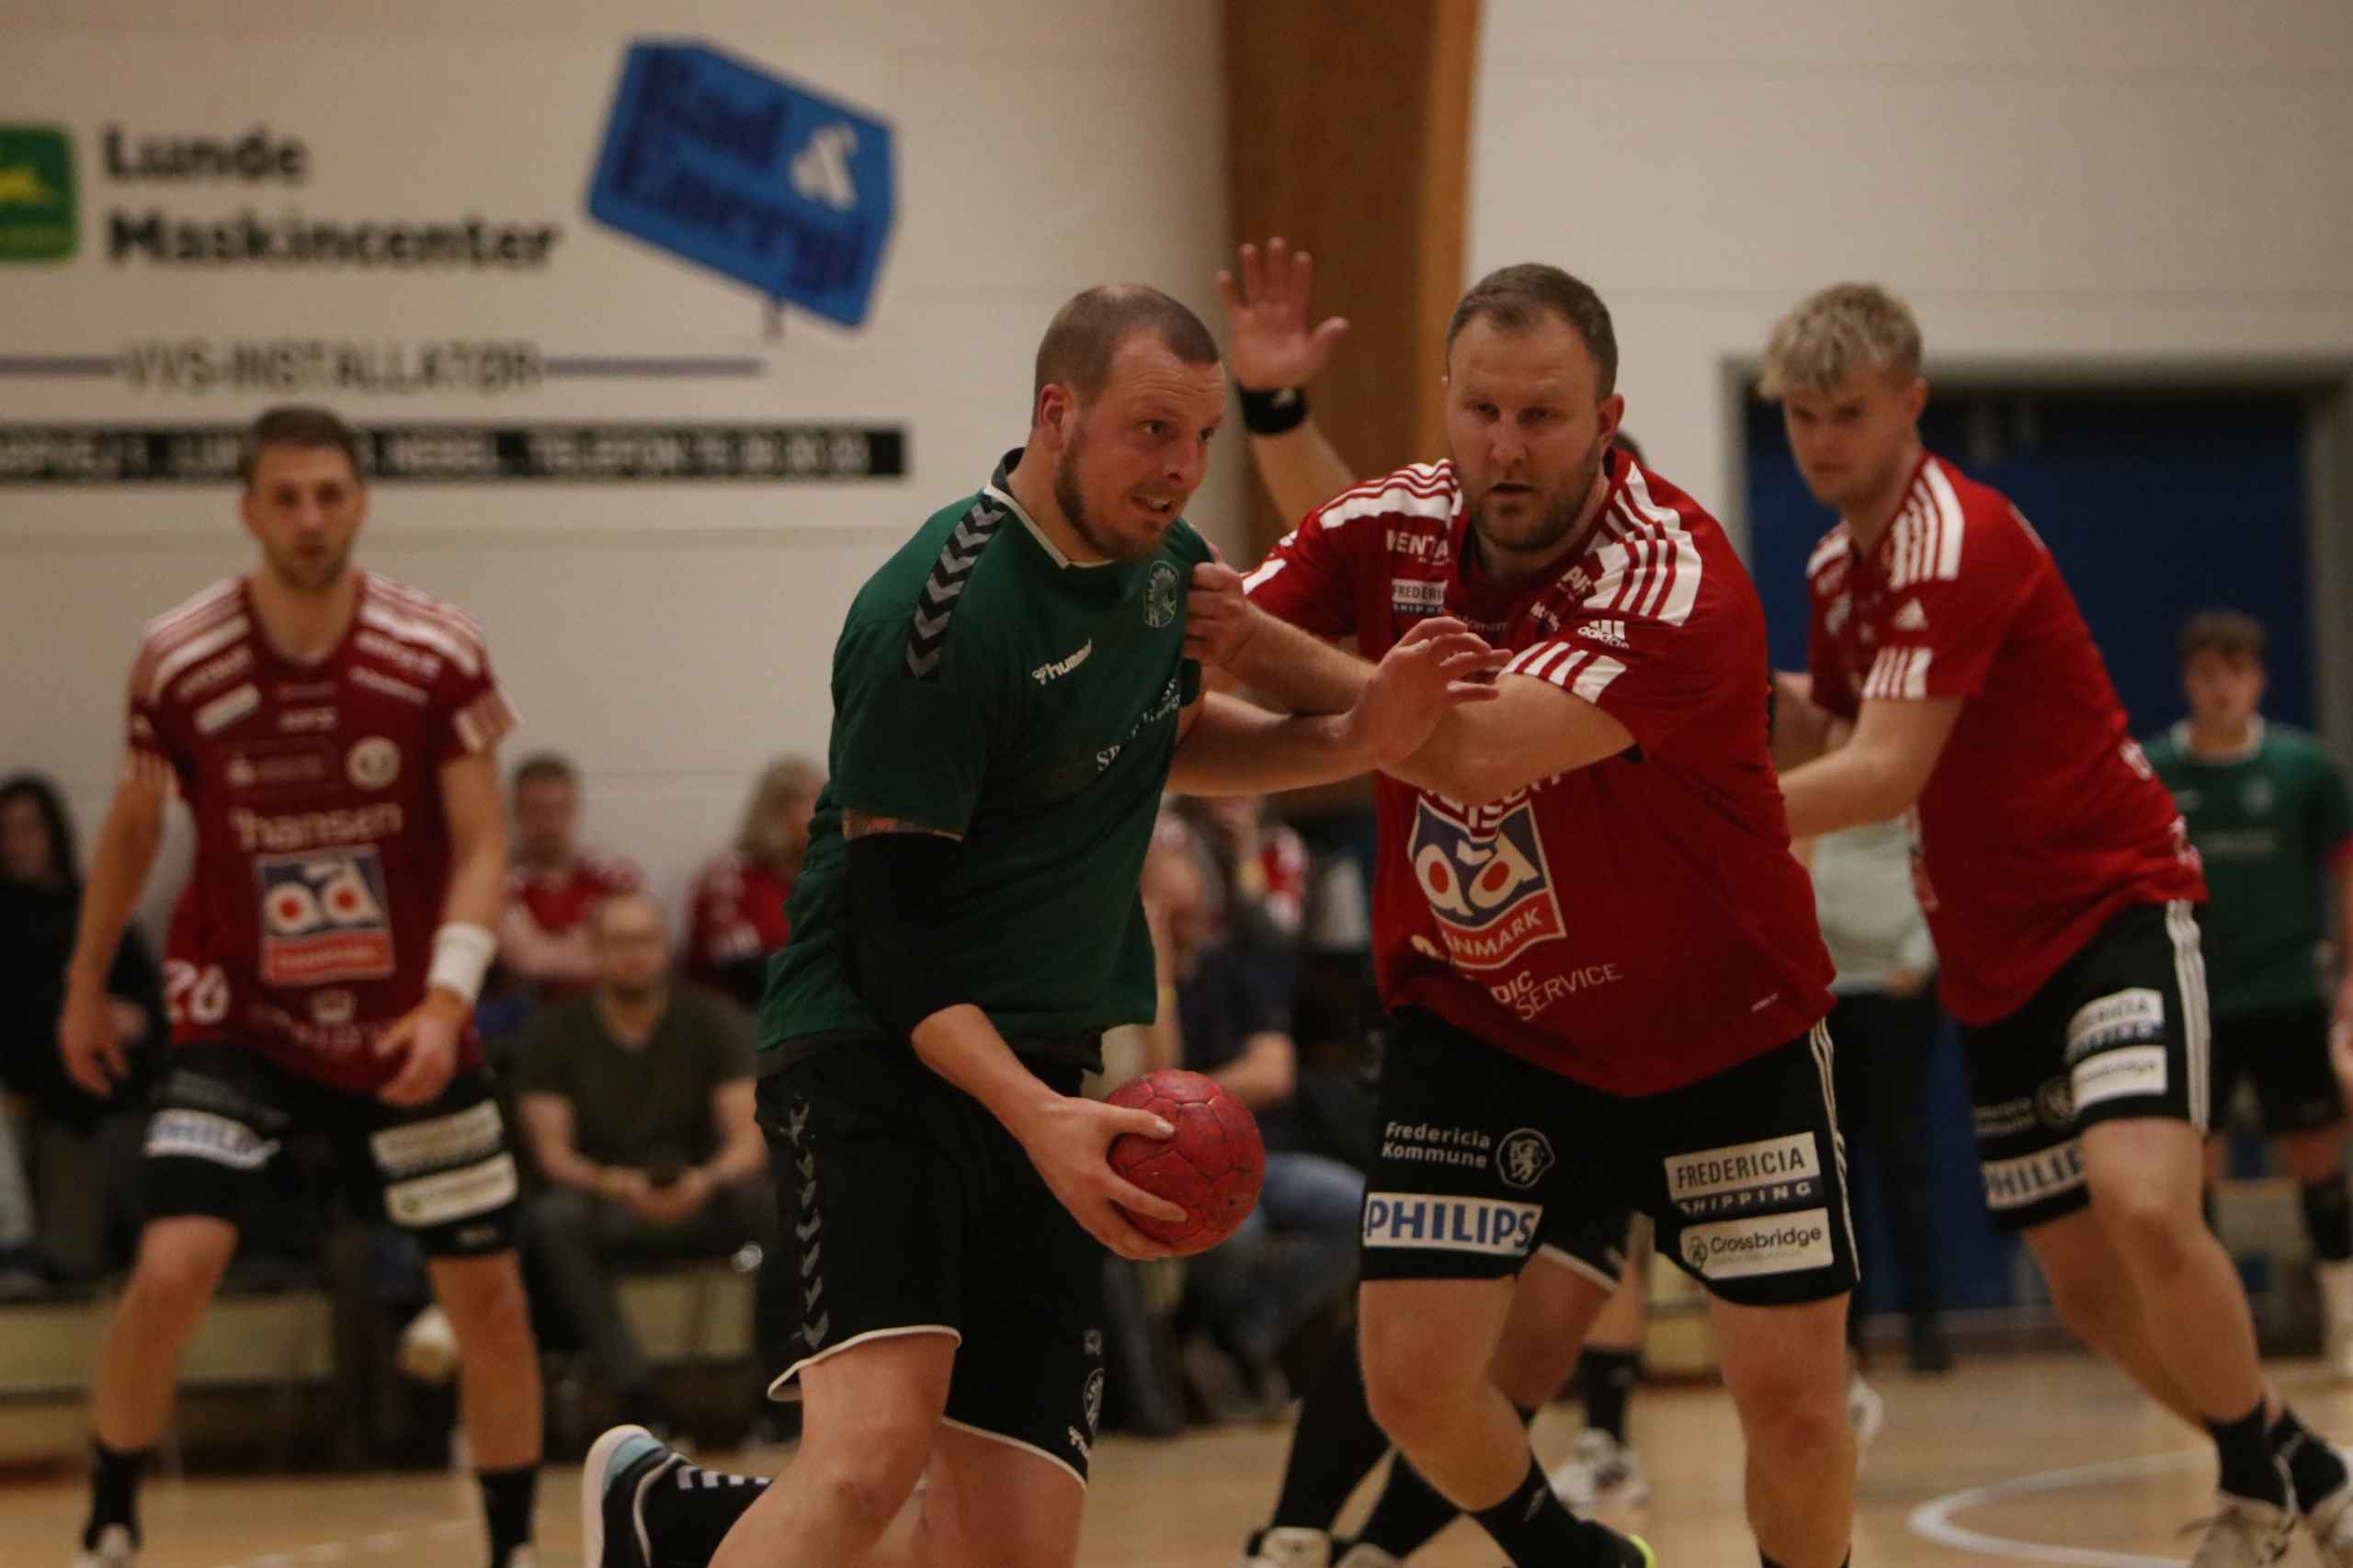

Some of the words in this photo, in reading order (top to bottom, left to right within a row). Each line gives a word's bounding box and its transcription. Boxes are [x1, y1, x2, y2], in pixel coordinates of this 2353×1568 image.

[104, 127, 305, 179] Lunde
[109, 211, 557, 264] Maskincenter
[1516, 963, 1624, 1020] SERVICE
[1381, 1141, 1487, 1169] Kommune
[1385, 1121, 1491, 1148] Fredericia
[1677, 1146, 1806, 1189] FREDERICIA
[1679, 1181, 1812, 1214] SHIPPING
[1366, 1199, 1536, 1248] PHILIPS
[1710, 1227, 1823, 1255] Crossbridge
